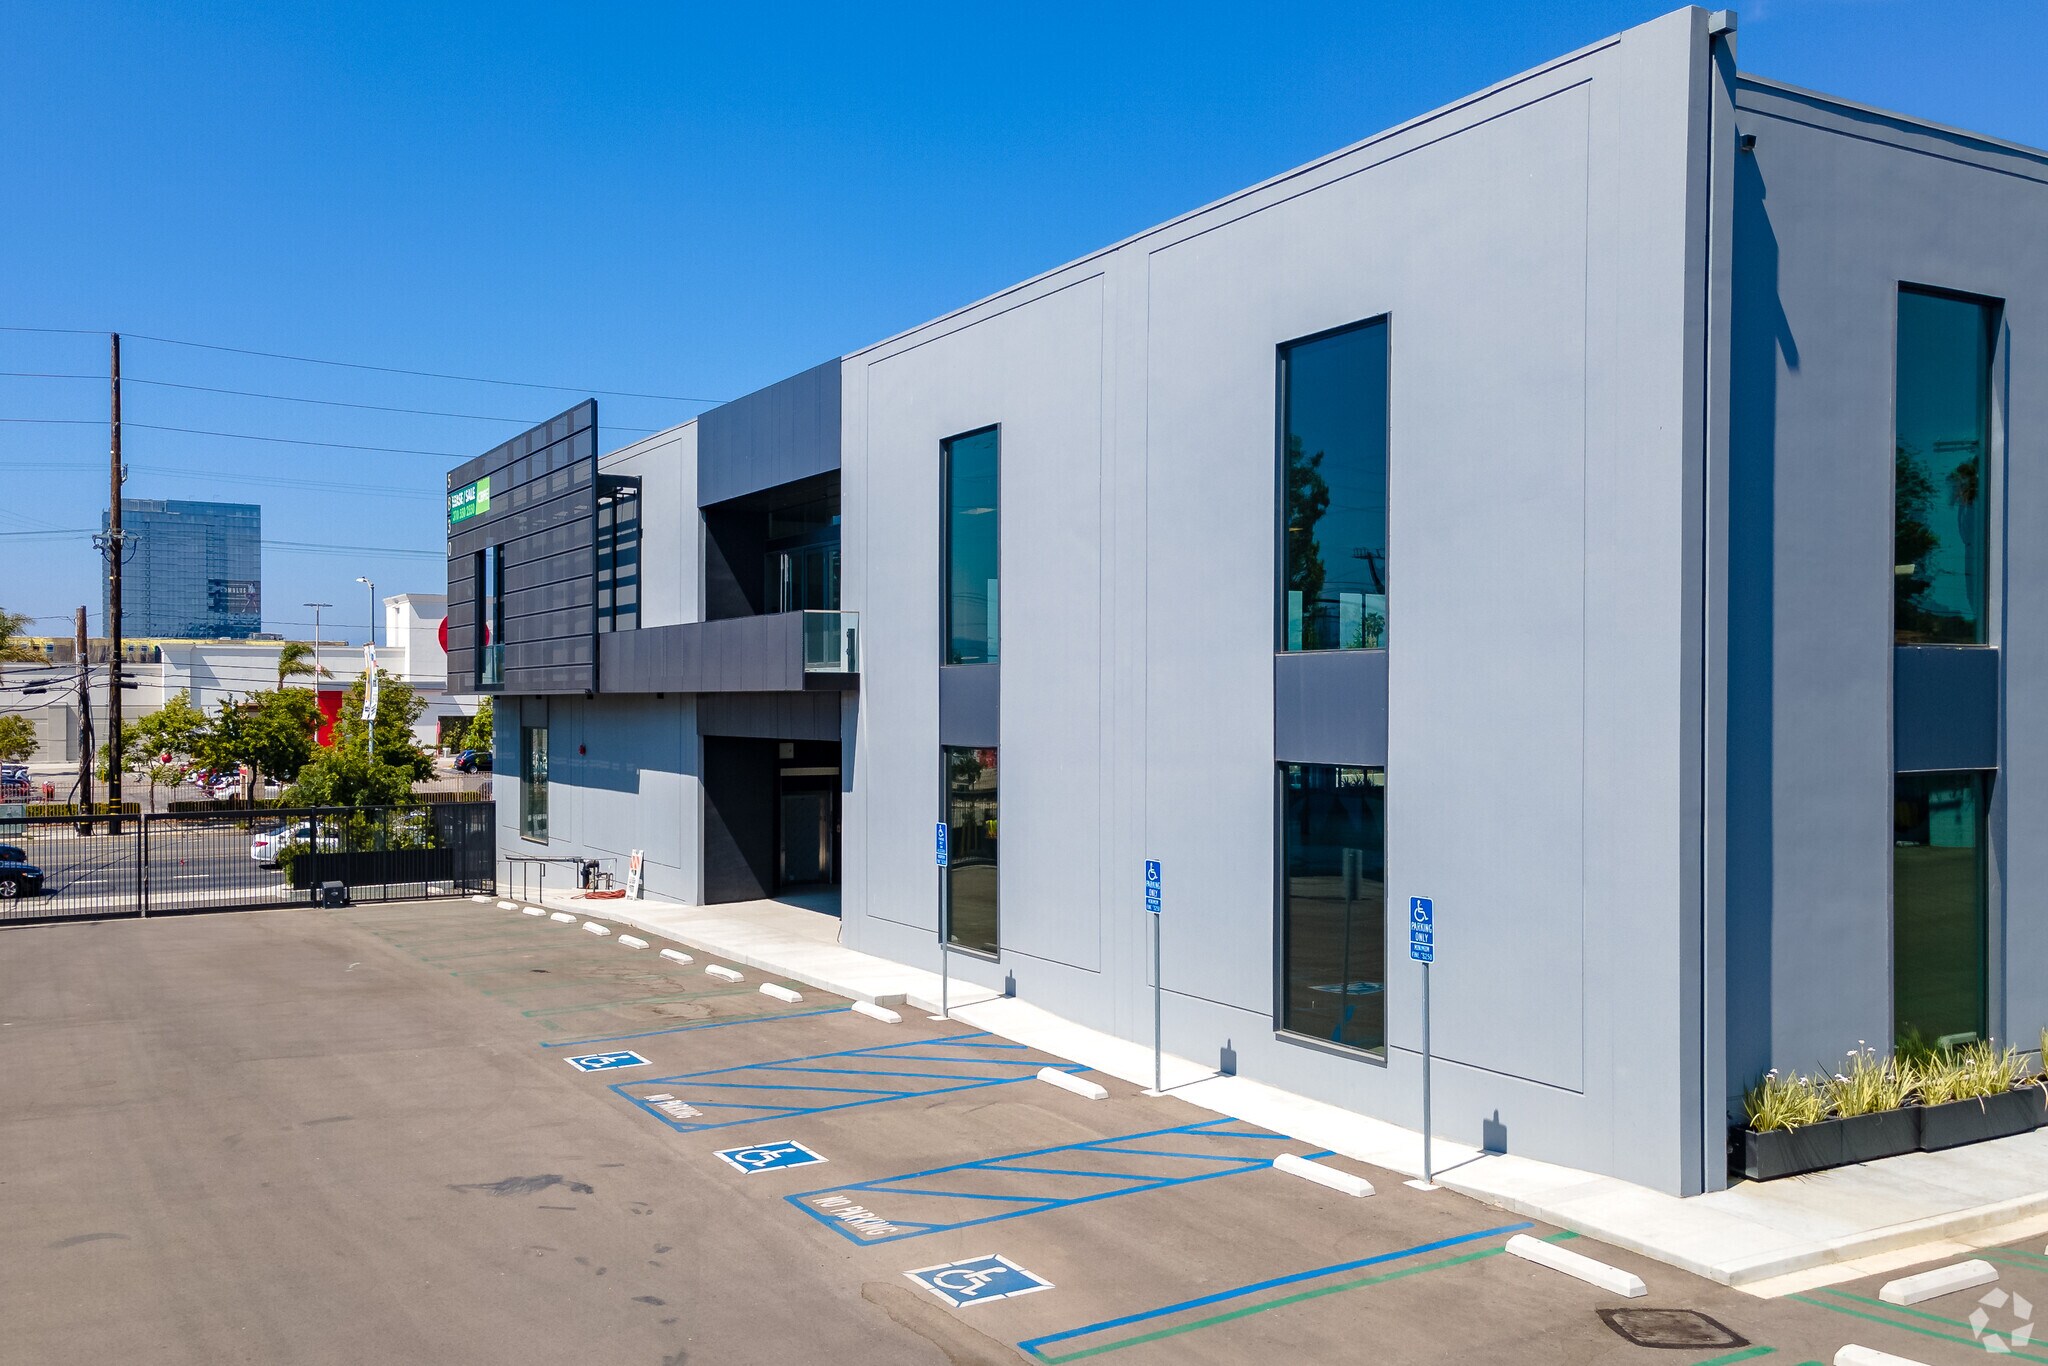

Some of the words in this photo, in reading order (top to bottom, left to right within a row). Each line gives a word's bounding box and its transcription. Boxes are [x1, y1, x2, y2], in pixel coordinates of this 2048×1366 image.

[465, 486, 476, 503] SALE
[1411, 921, 1432, 933] PARKING
[1415, 932, 1429, 942] ONLY
[812, 1195, 852, 1208] NO
[829, 1205, 898, 1236] PARKING
